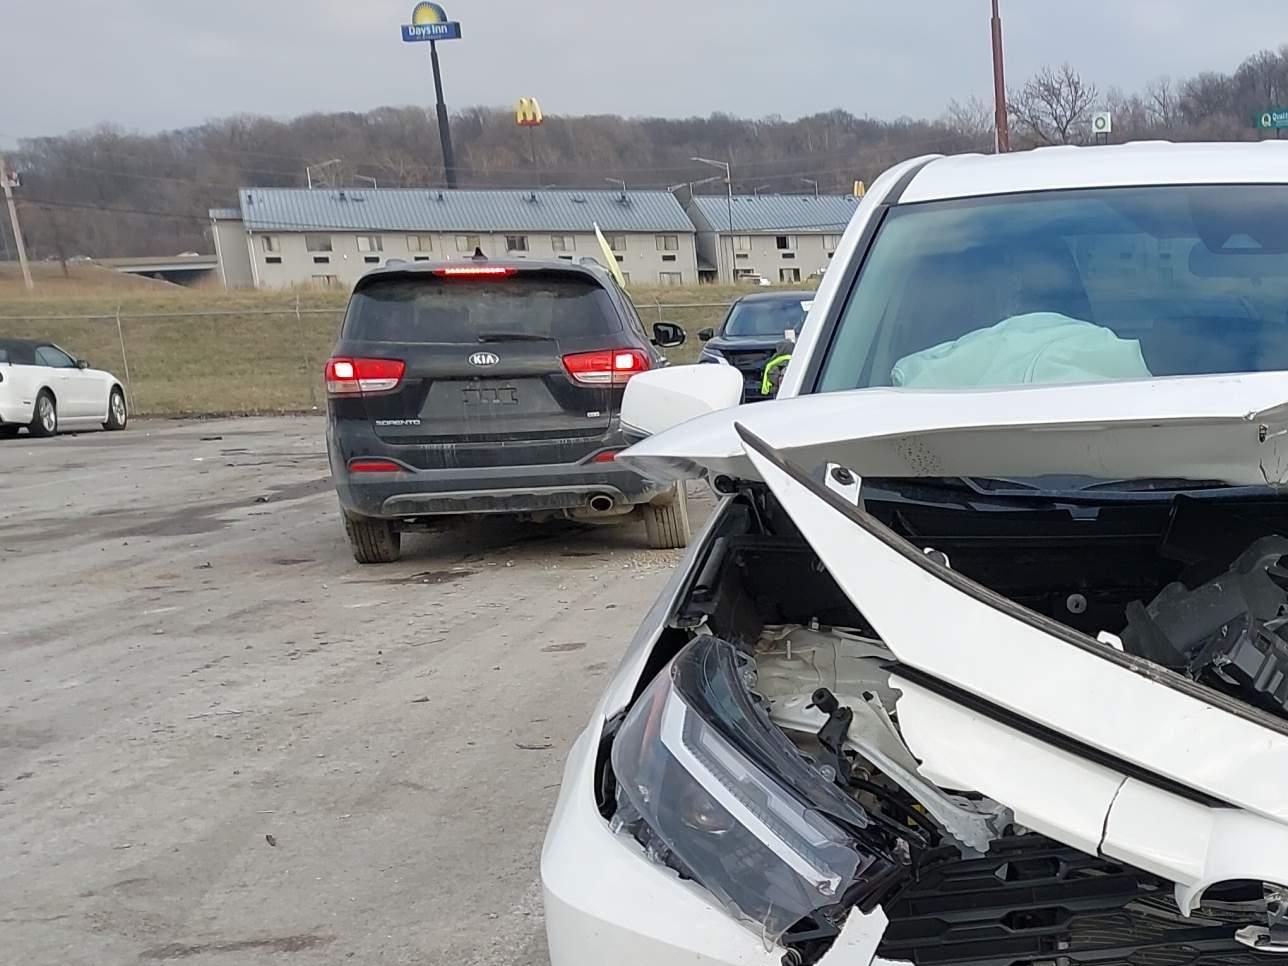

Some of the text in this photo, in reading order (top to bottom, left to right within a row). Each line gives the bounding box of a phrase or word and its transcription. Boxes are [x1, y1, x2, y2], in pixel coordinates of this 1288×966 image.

[408, 24, 448, 37] Days Inn
[473, 355, 495, 365] KIA
